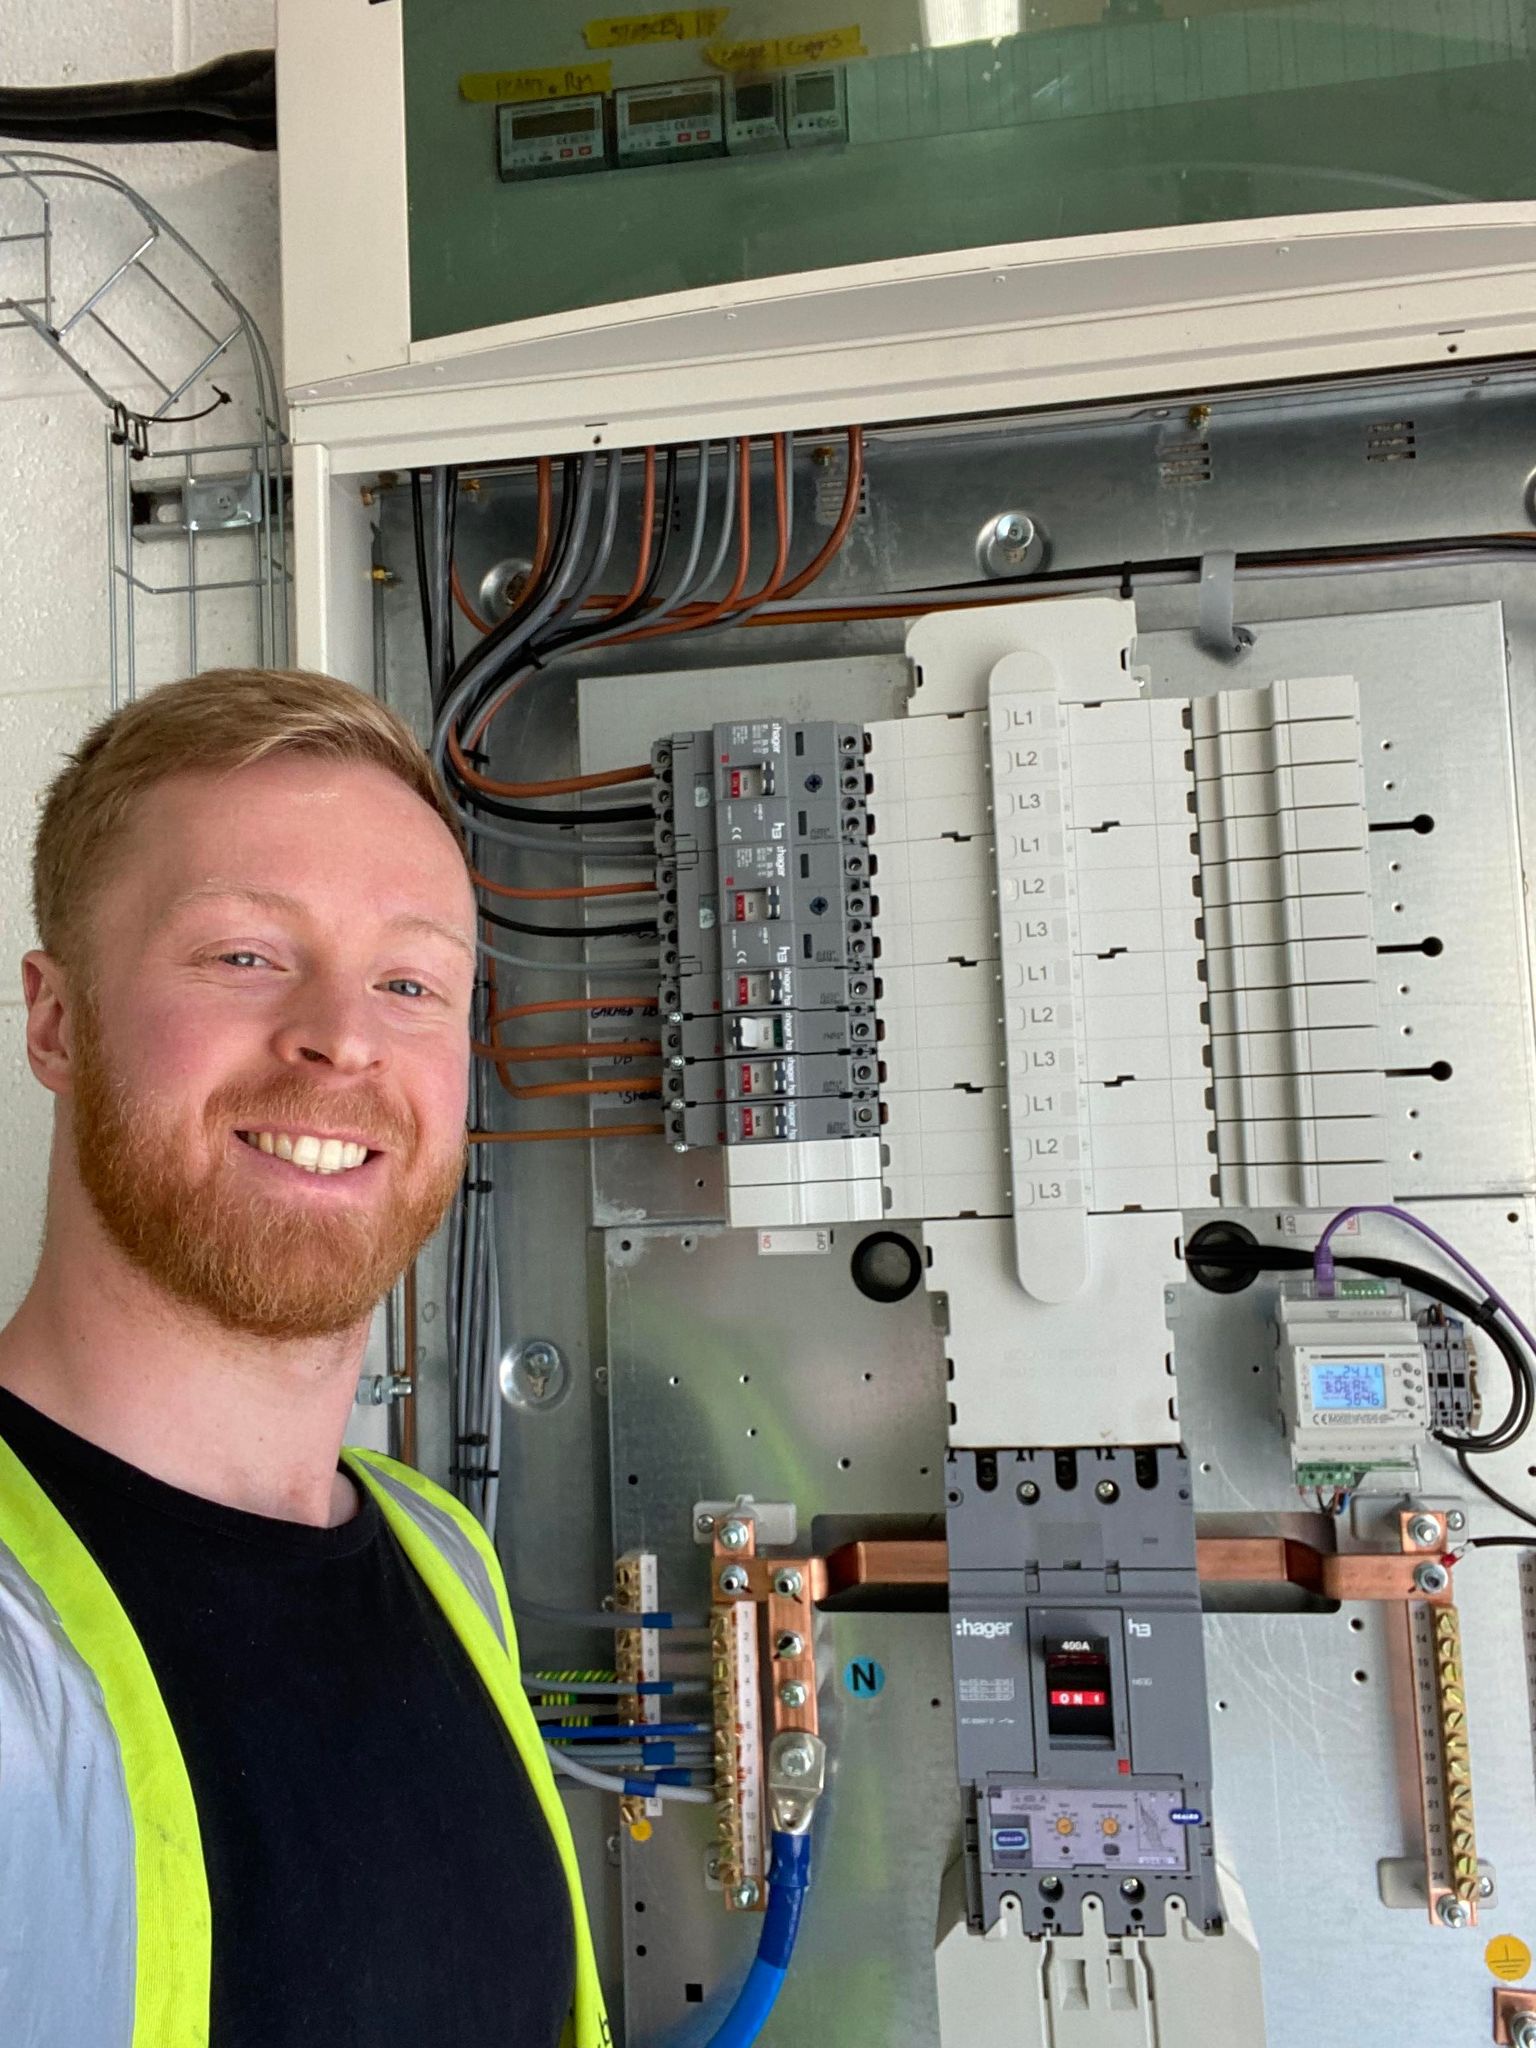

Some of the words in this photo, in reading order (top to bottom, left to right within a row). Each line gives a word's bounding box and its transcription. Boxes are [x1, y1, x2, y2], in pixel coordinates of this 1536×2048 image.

[1013, 710, 1033, 726] L1
[1015, 751, 1038, 768] L2
[1018, 793, 1041, 810] L3
[1020, 837, 1041, 853] L1
[1022, 878, 1045, 895] L2
[1025, 921, 1048, 938] L3
[1027, 965, 1047, 981] L1
[1031, 1006, 1053, 1023] L2
[1033, 1050, 1056, 1067] L3
[1033, 1096, 1053, 1112] L1
[1035, 1138, 1058, 1155] L2
[1038, 1182, 1061, 1199] L3
[1286, 1215, 1295, 1234] OFF
[817, 1231, 826, 1250] OFF
[1416, 1633, 1427, 1643] 14
[852, 1662, 875, 1691] N
[1058, 1693, 1083, 1705] ON
